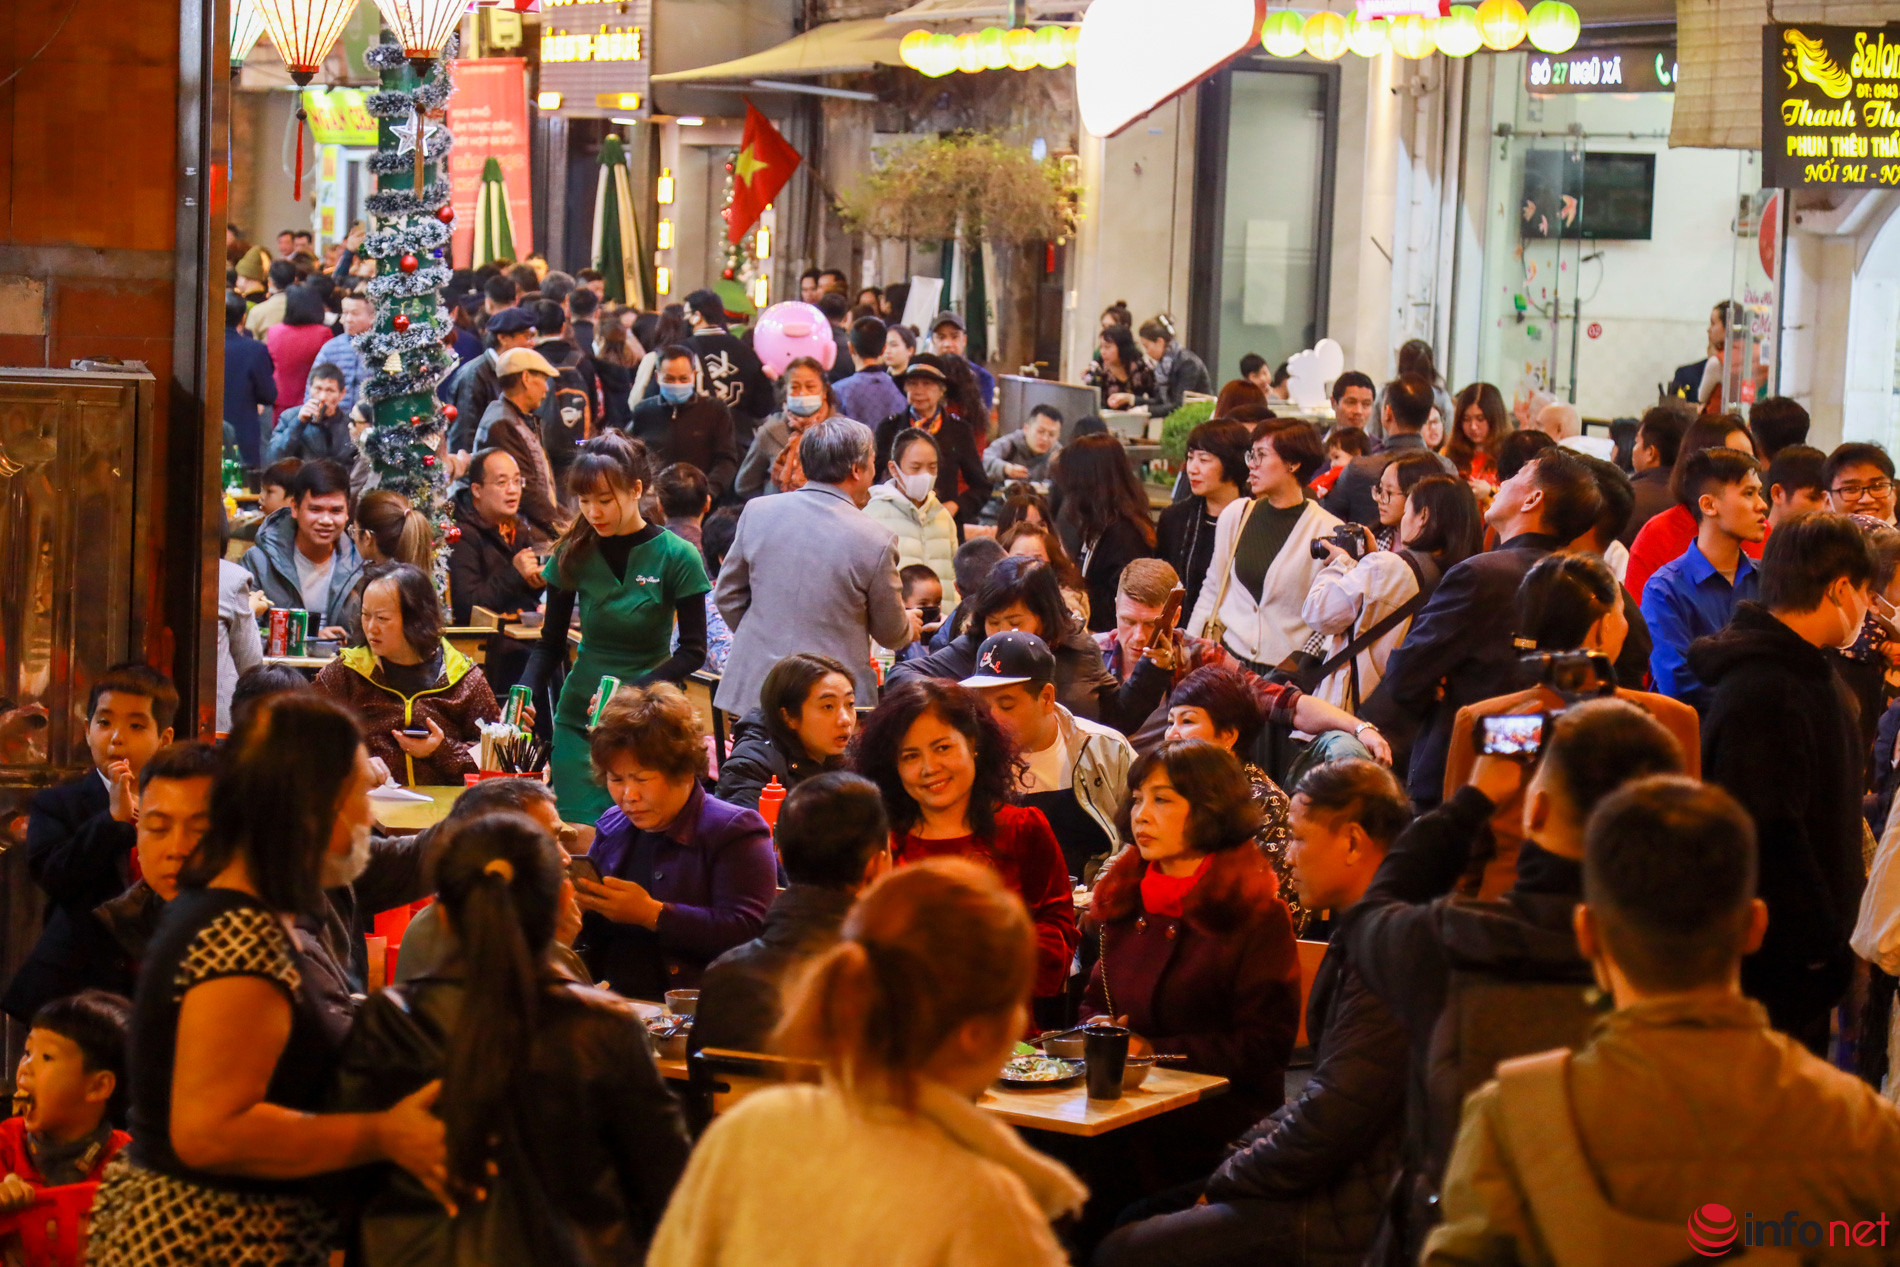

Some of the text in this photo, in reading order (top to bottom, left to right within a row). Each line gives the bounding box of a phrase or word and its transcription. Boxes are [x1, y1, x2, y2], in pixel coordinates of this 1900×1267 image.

[1552, 62, 1568, 84] 27
[1781, 98, 1857, 127] Thanh
[1786, 136, 1828, 156] PHUN
[1830, 132, 1868, 157] THÊU
[1804, 157, 1840, 183] NỐI
[1842, 164, 1868, 183] MI
